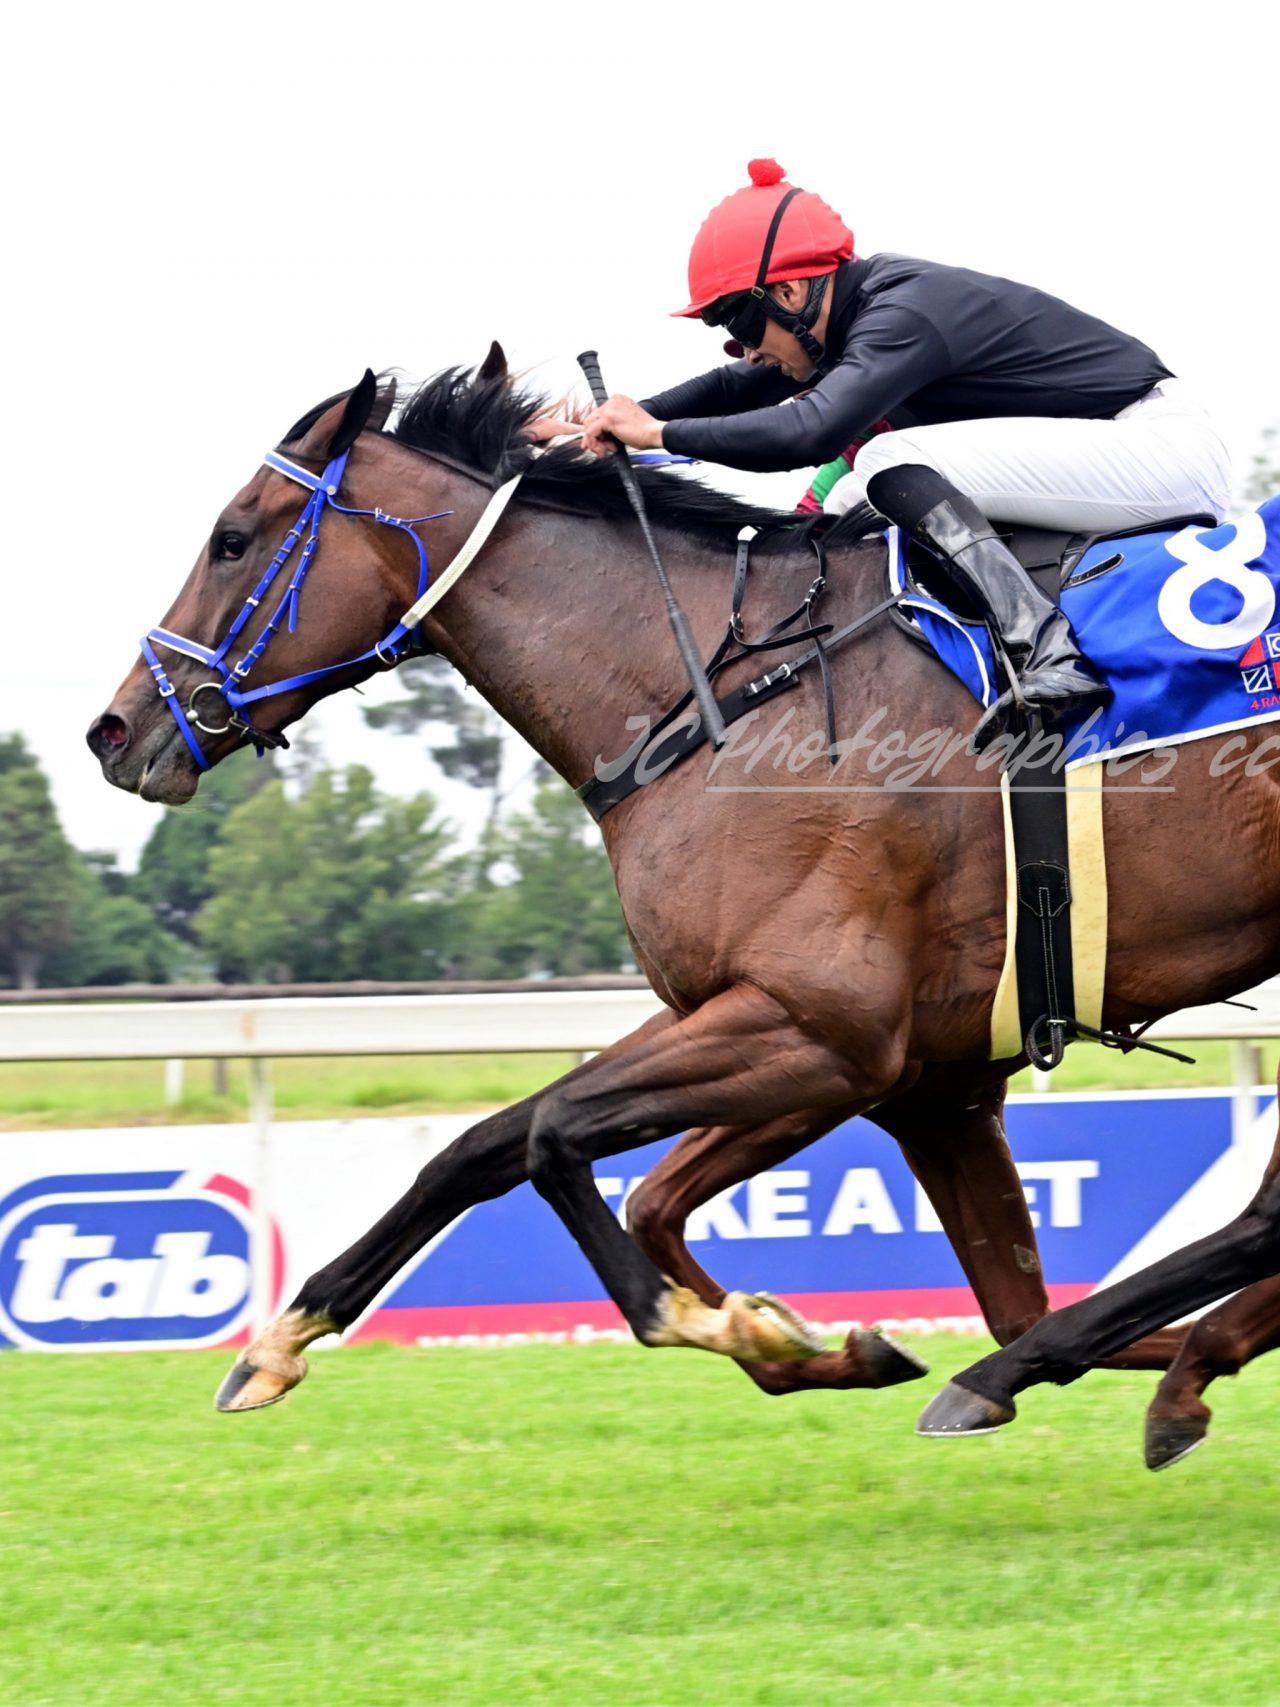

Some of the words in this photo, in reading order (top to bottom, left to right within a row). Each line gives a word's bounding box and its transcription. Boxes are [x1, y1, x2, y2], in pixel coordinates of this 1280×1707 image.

[1158, 512, 1276, 650] 8
[1250, 700, 1260, 711] 4
[822, 1168, 904, 1235] A
[11, 1223, 251, 1323] tab
